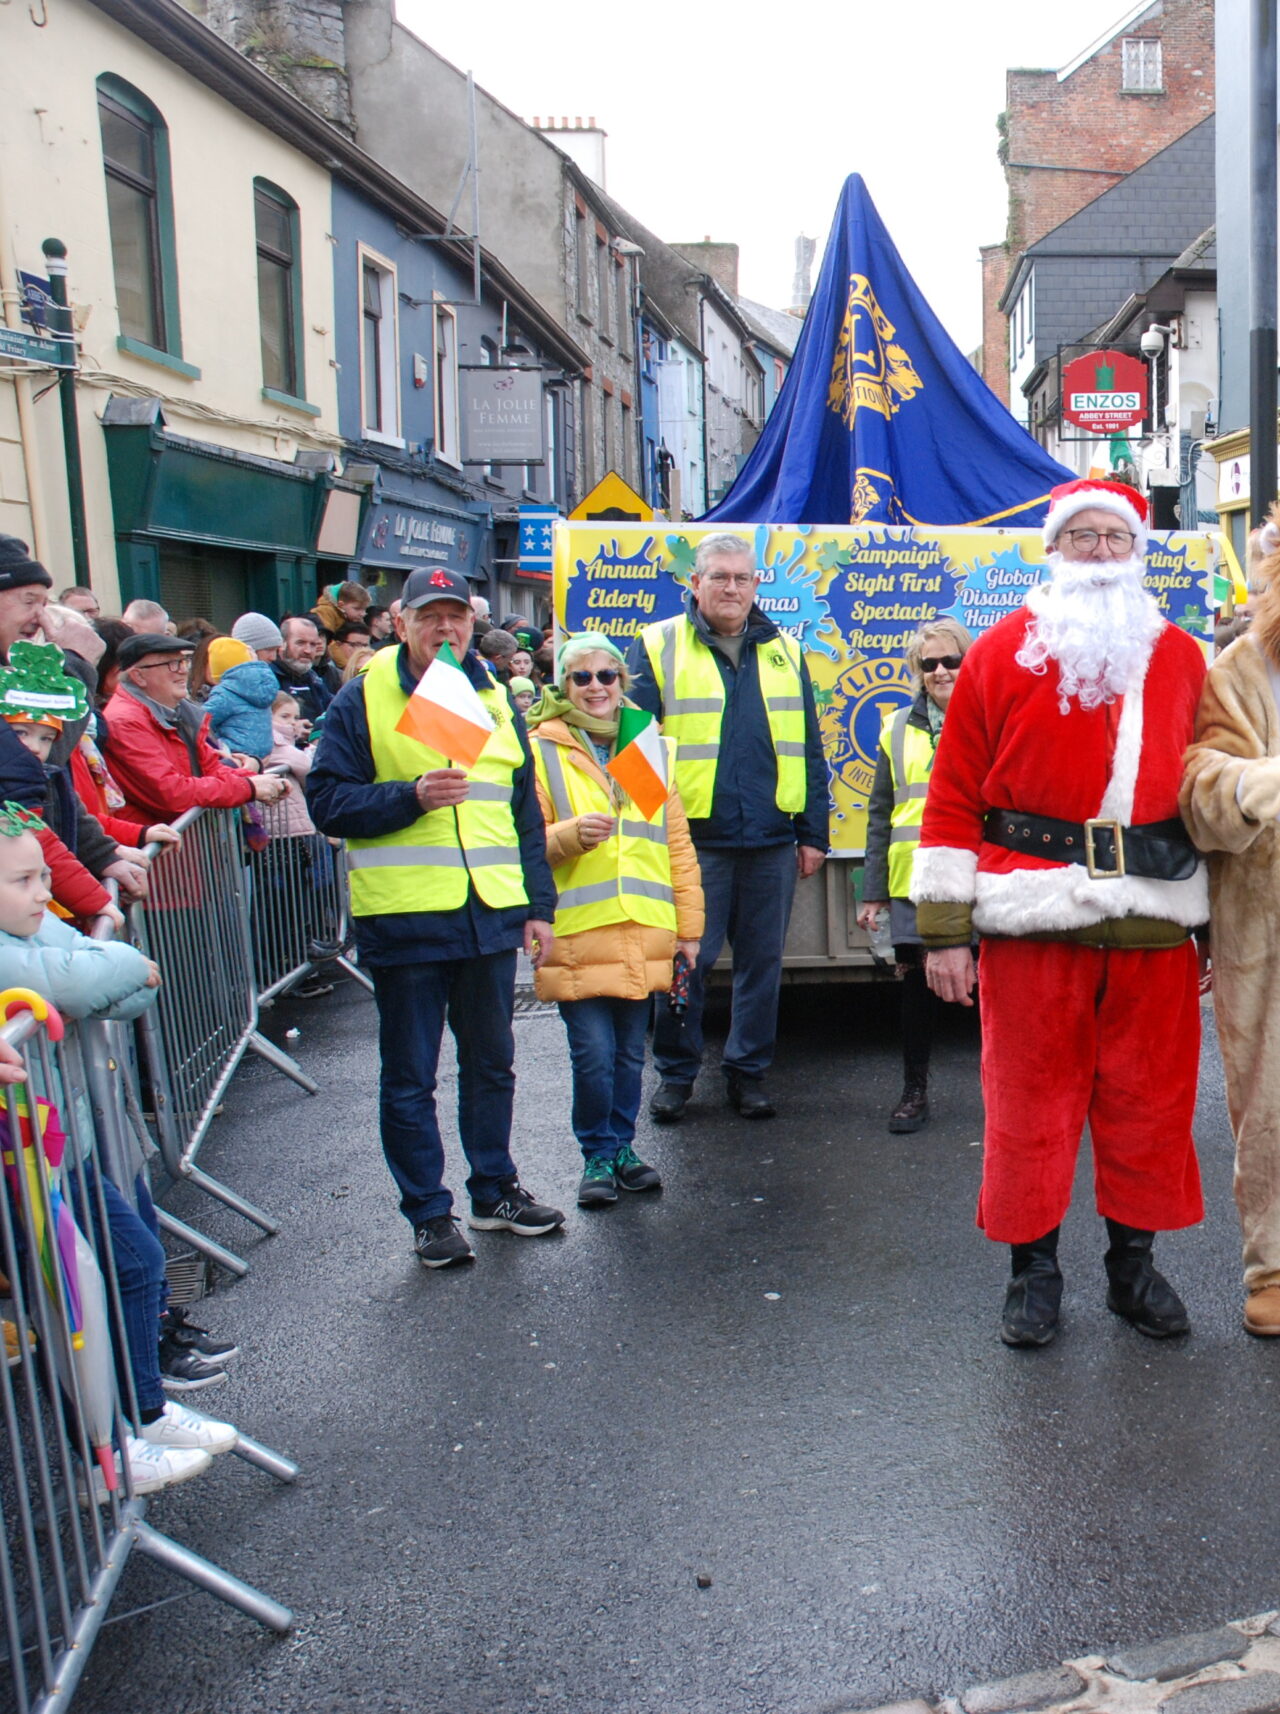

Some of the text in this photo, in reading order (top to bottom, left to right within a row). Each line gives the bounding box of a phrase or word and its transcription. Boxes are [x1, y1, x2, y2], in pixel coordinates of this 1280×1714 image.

[1074, 394, 1136, 408] ENZOS
[847, 544, 942, 570] Campaign
[1143, 550, 1184, 573] rting
[585, 558, 658, 582] Annual
[985, 567, 1041, 590] Global
[1143, 570, 1192, 593] ospice
[844, 572, 942, 598] Sight First
[586, 588, 656, 613] Elderly
[850, 600, 937, 626] Spectacle
[847, 661, 912, 693] LION
[849, 766, 875, 790] INTE
